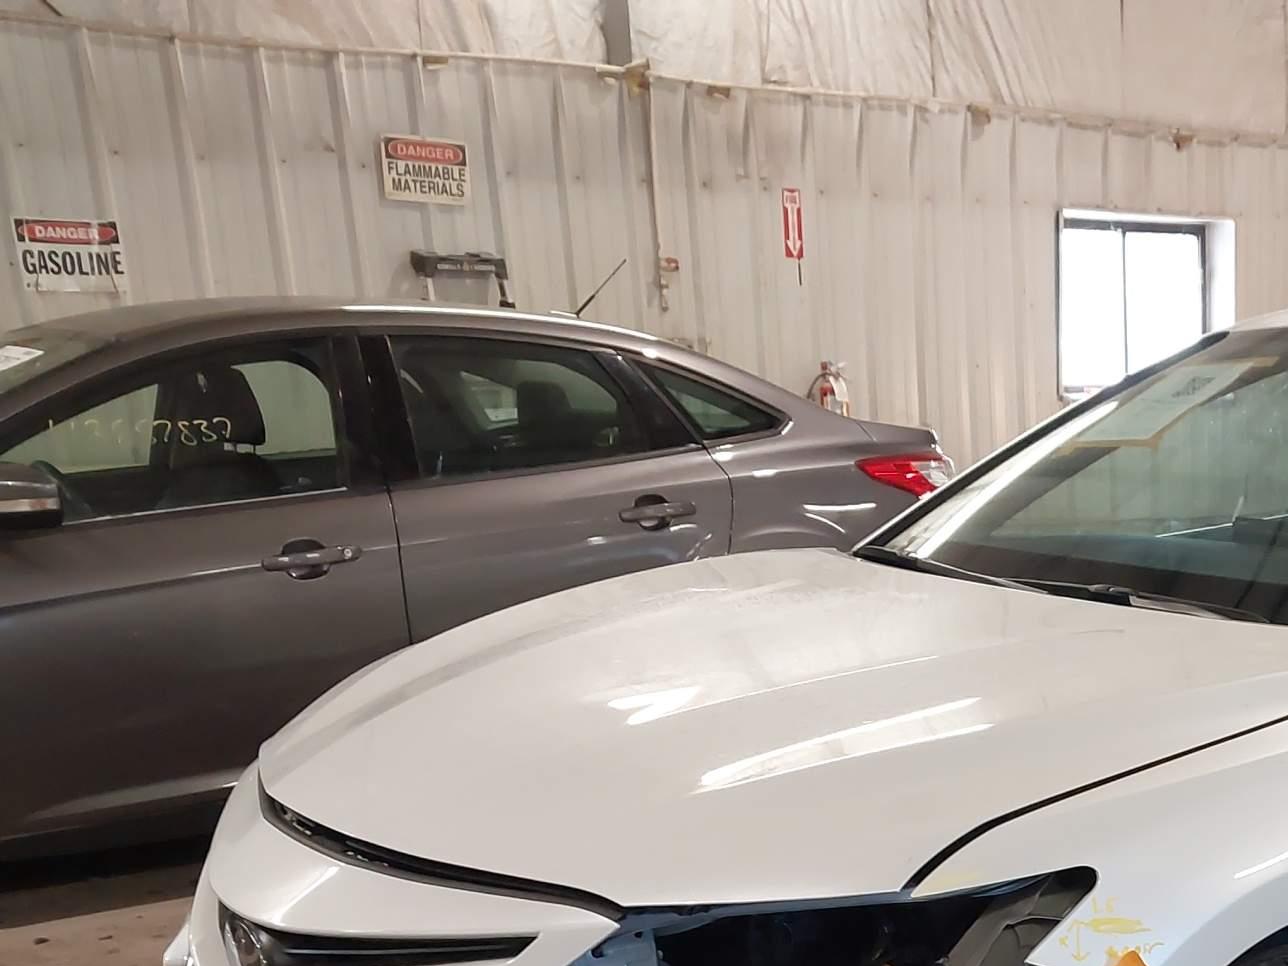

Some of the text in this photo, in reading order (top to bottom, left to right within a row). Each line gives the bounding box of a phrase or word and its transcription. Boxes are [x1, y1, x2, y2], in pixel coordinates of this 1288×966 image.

[397, 143, 454, 160] DANGER
[387, 161, 466, 182] FLAMMABLE
[392, 177, 464, 197] MATERIALS
[34, 225, 99, 240] DANGER
[22, 249, 124, 276] GASOLINE
